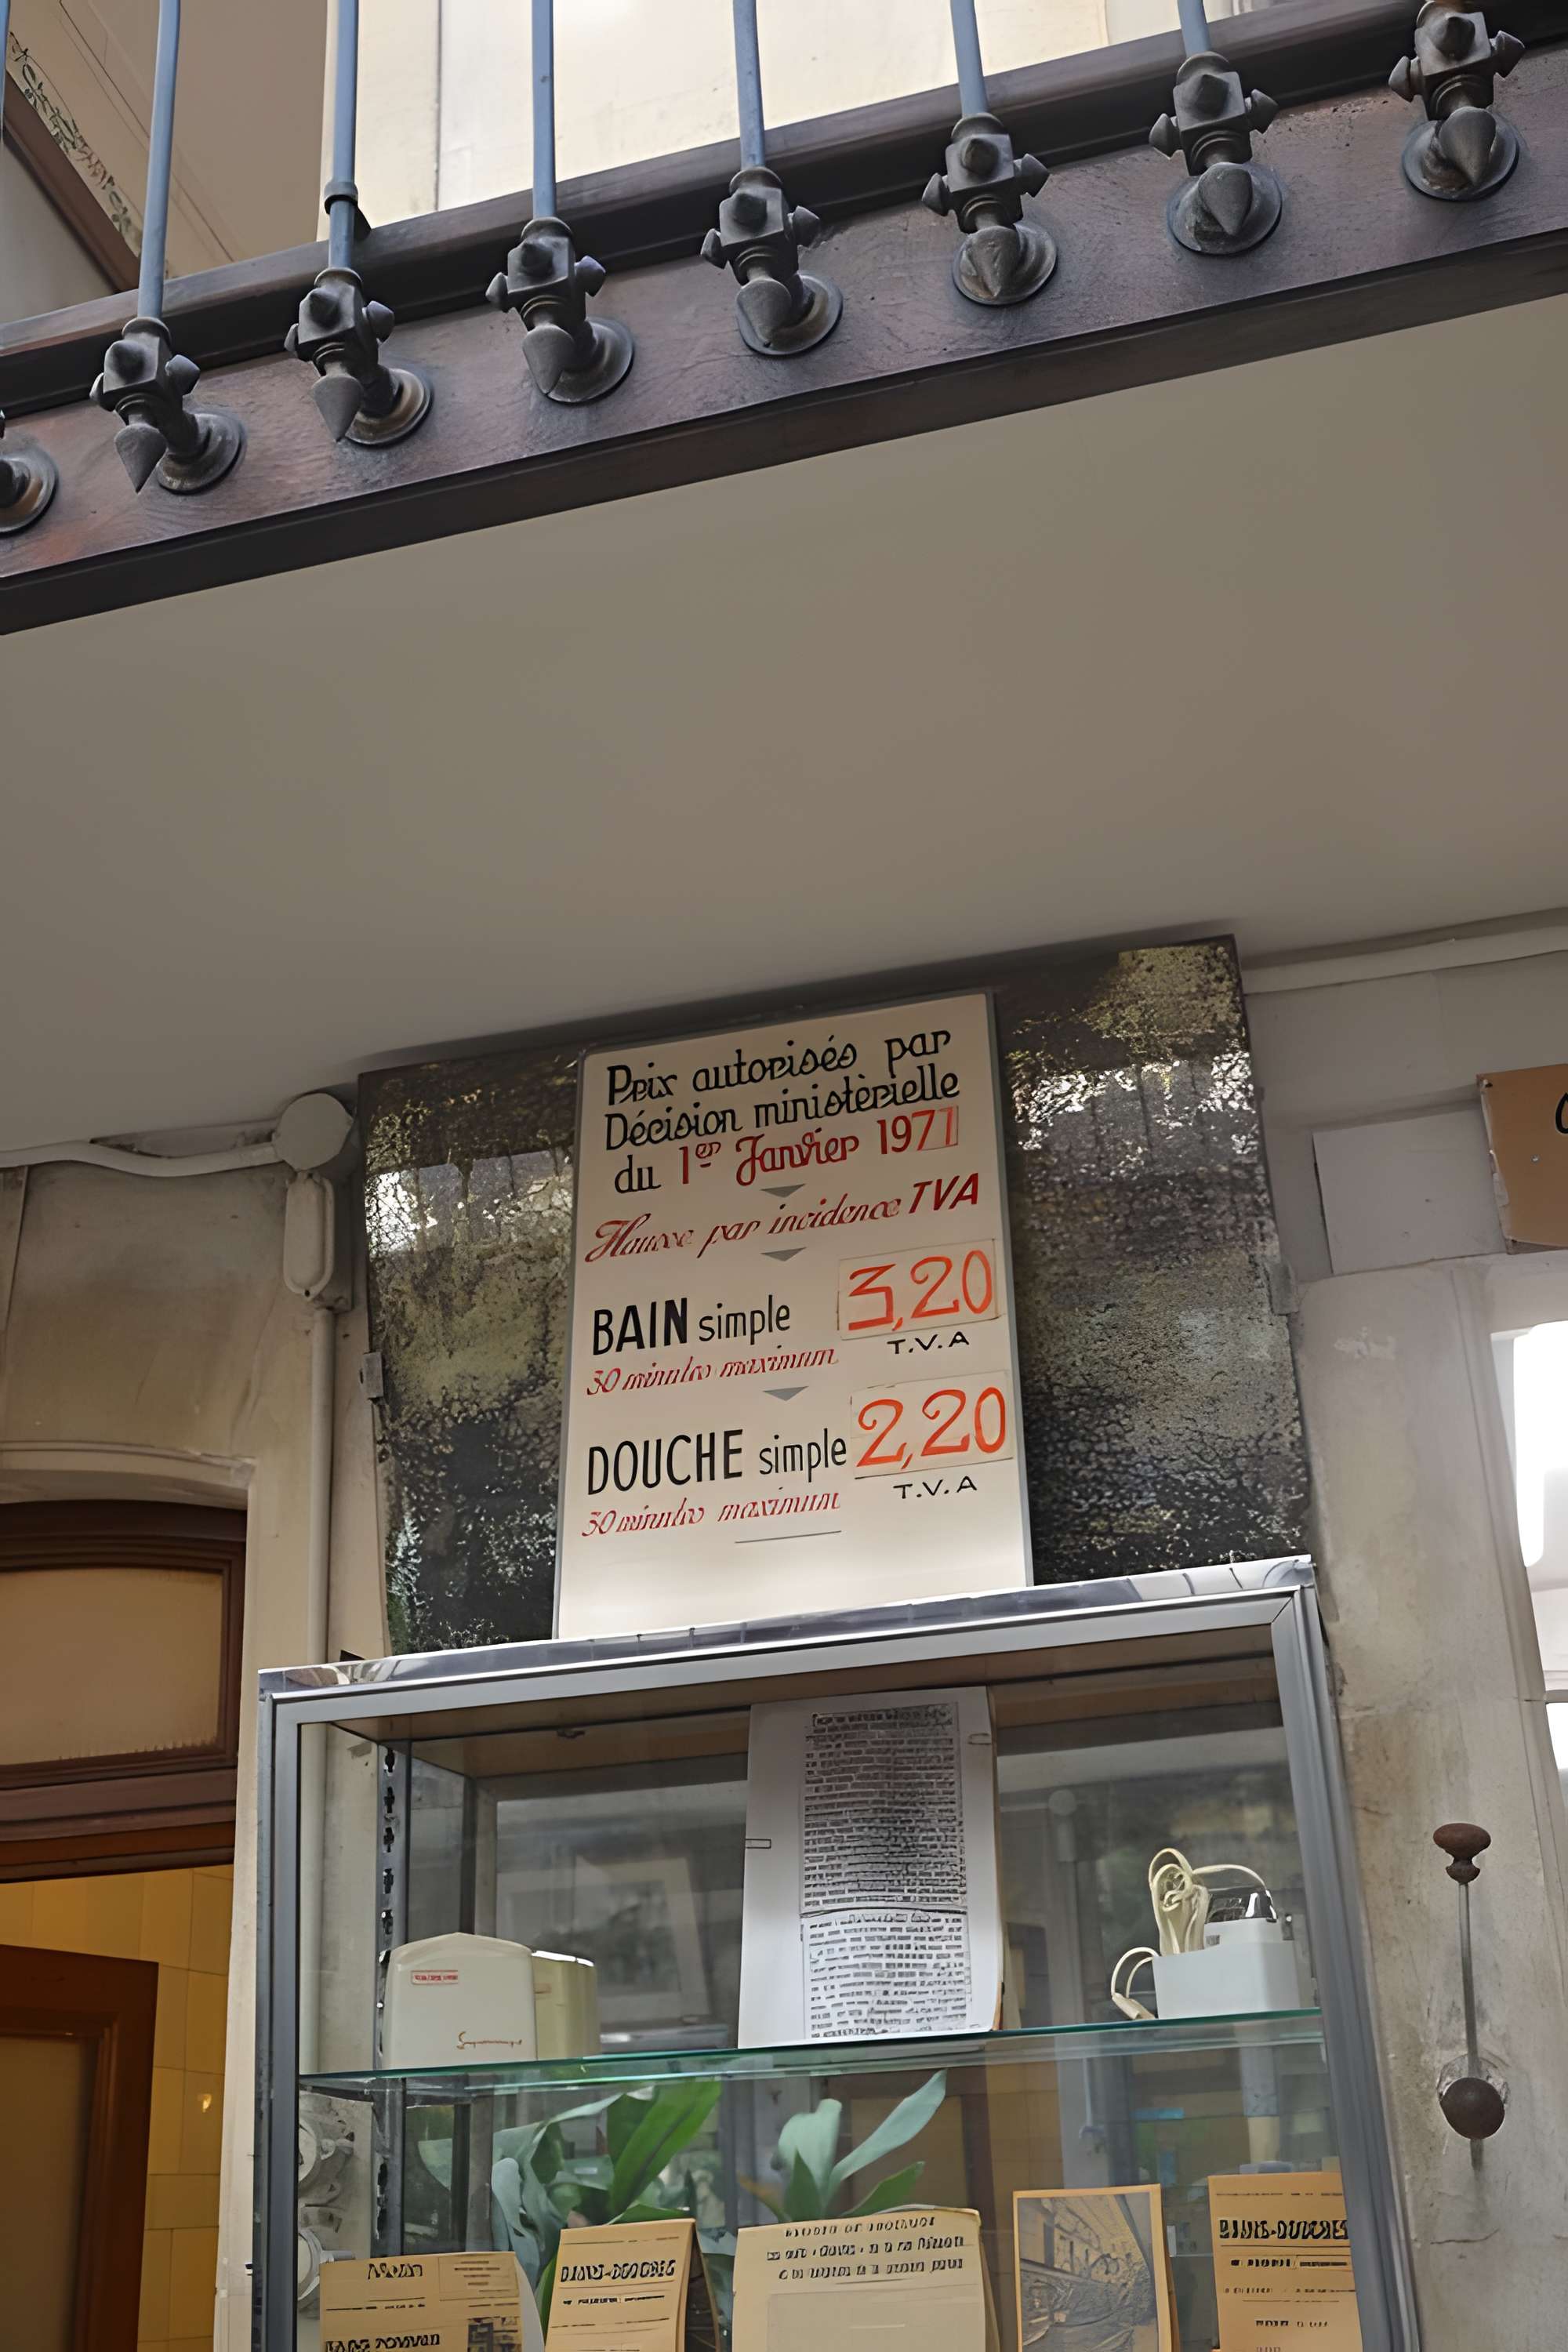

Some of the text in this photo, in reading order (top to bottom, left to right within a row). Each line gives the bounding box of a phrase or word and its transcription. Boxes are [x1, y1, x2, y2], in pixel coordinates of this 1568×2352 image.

[607, 1030, 951, 1105] Prix autorisés par
[604, 1102, 743, 1150] Décision
[614, 1154, 662, 1193] du
[735, 1127, 859, 1186] Janvier
[697, 1221, 760, 1258] par
[908, 1172, 979, 1214] TVA
[593, 1250, 992, 1356] BAIN simple 3,20
[887, 1331, 969, 1355] T.V.A
[588, 1386, 1006, 1495] DOUCHE simple 2,20
[893, 1475, 978, 1499] T.V.A
